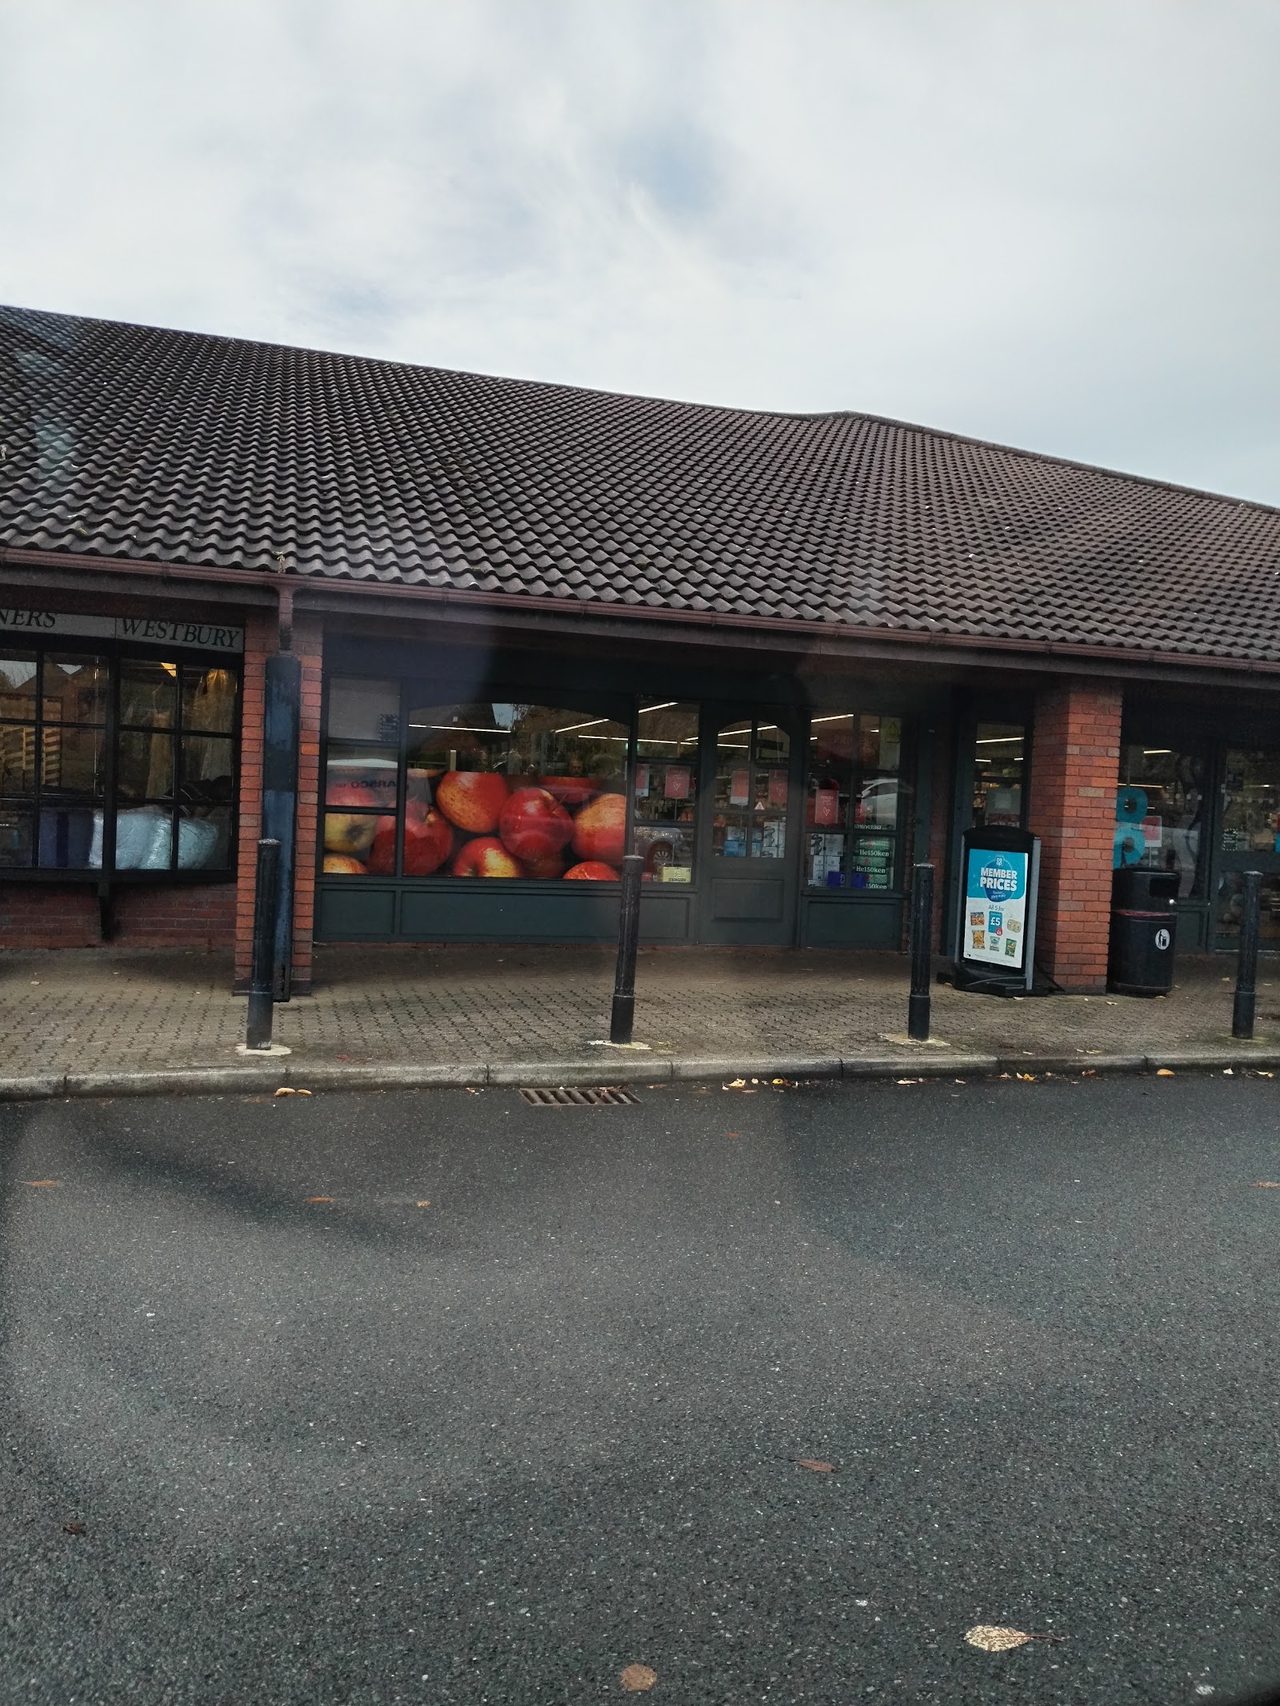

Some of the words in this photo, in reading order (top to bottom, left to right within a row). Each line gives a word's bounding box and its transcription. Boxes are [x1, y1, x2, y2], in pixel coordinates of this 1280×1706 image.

[121, 618, 240, 648] WESTBURY
[980, 867, 1017, 880] MEMBER
[980, 876, 1017, 892] PRICES
[990, 917, 1000, 926] £5
